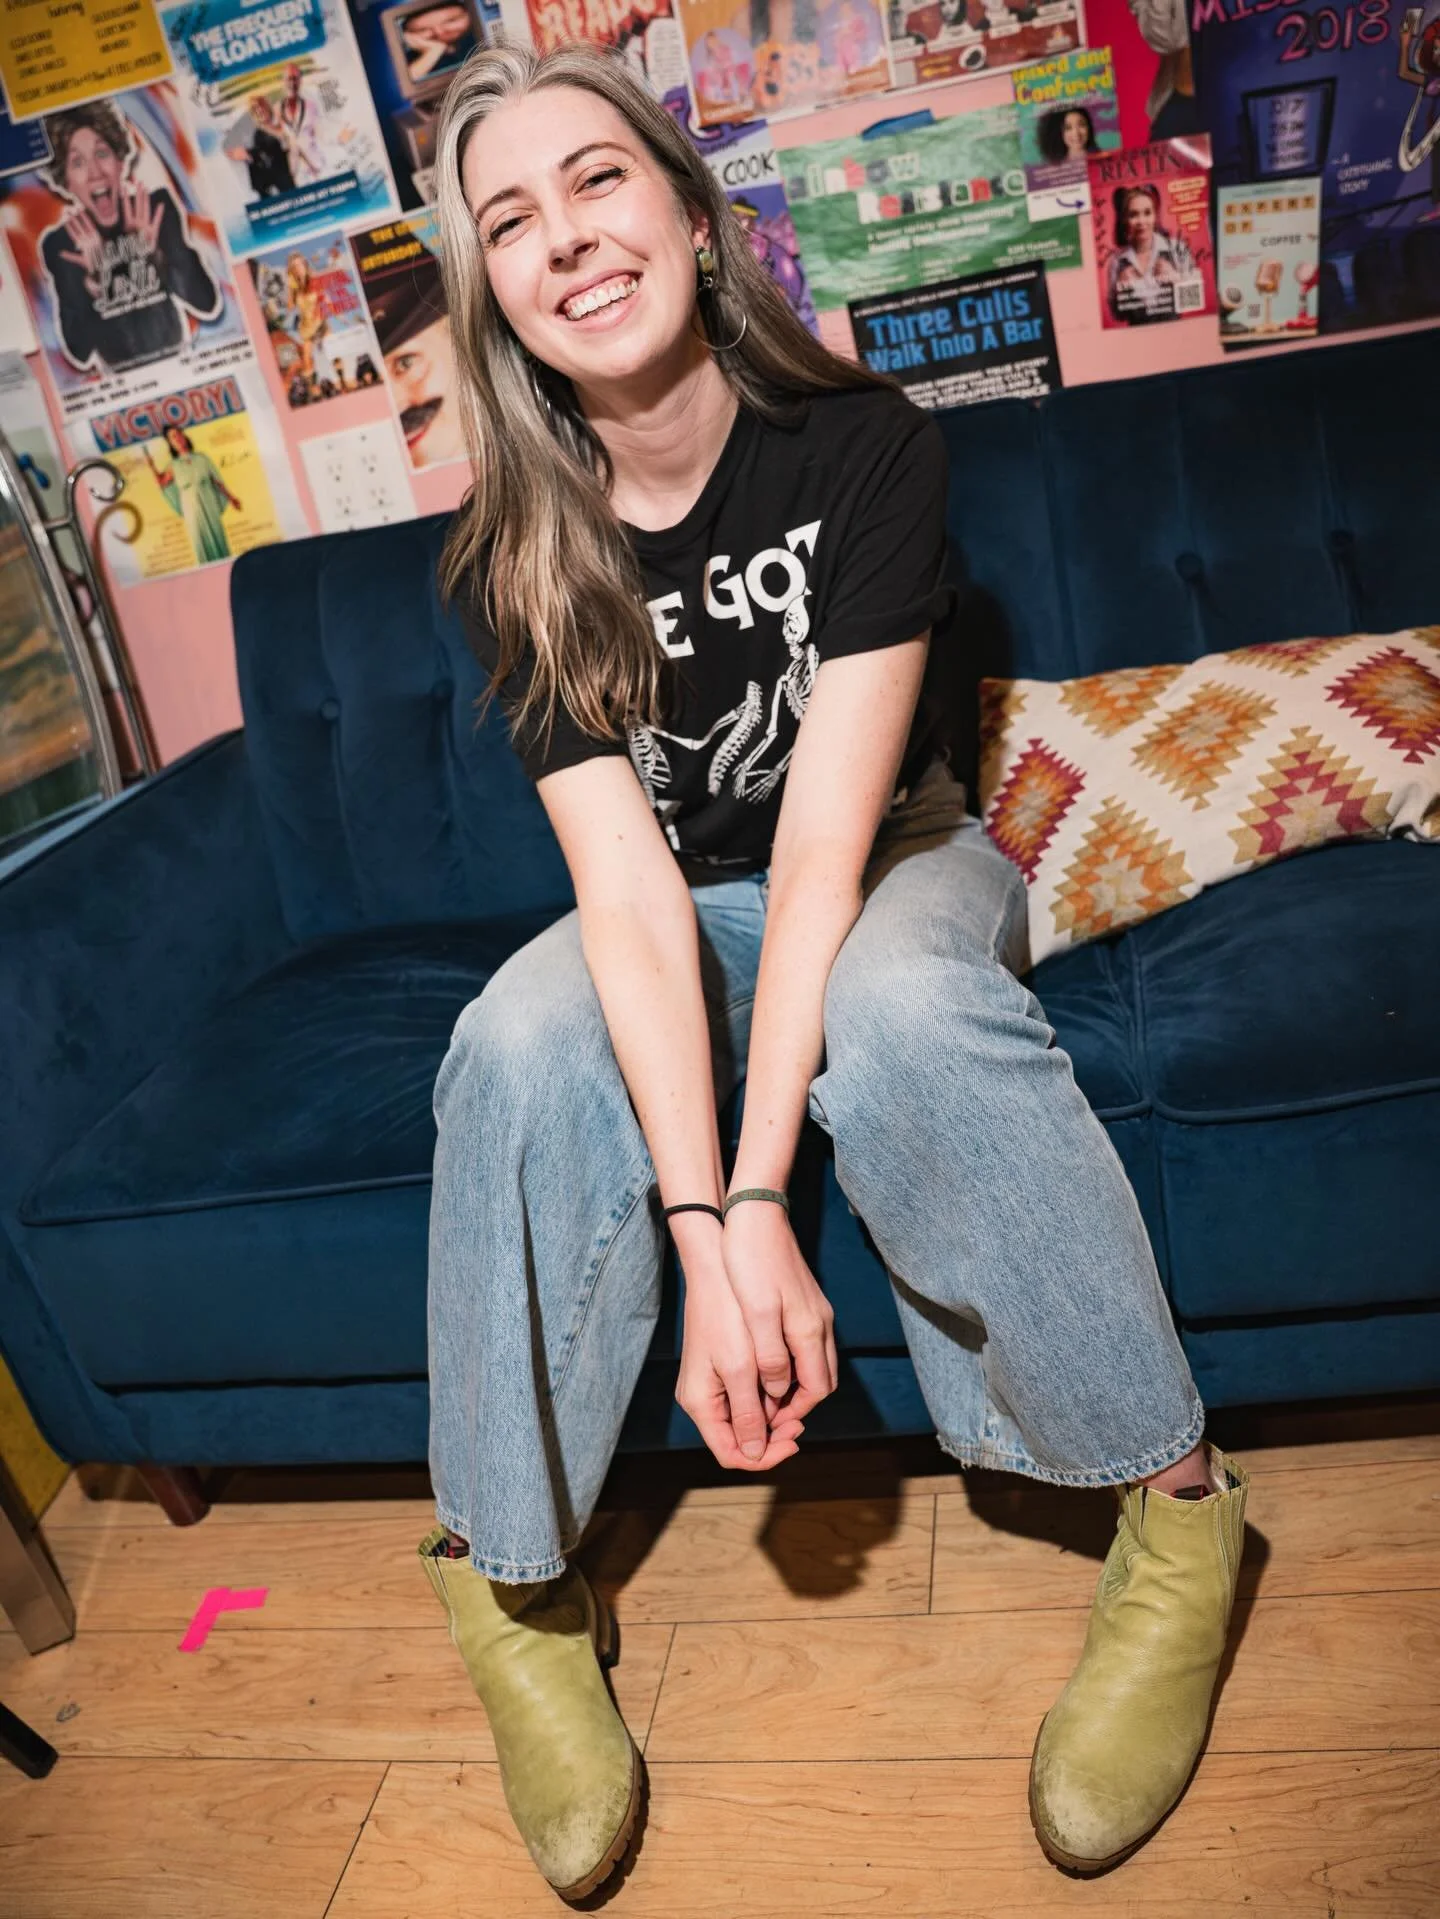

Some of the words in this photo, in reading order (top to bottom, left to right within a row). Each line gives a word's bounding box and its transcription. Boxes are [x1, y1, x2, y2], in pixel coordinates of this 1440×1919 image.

[189, 25, 226, 53] THE
[223, 0, 314, 41] FREQUENT
[208, 18, 310, 69] FLOATERS
[1275, 0, 1392, 63] 2018
[1075, 45, 1112, 70] and
[1016, 66, 1114, 105] Confused
[723, 150, 775, 187] COOK
[864, 342, 926, 374] Walk
[931, 333, 976, 361] Into
[982, 325, 999, 351] A
[1003, 317, 1044, 347] Bar
[866, 307, 953, 347] Three
[92, 376, 243, 447] VICTORY!
